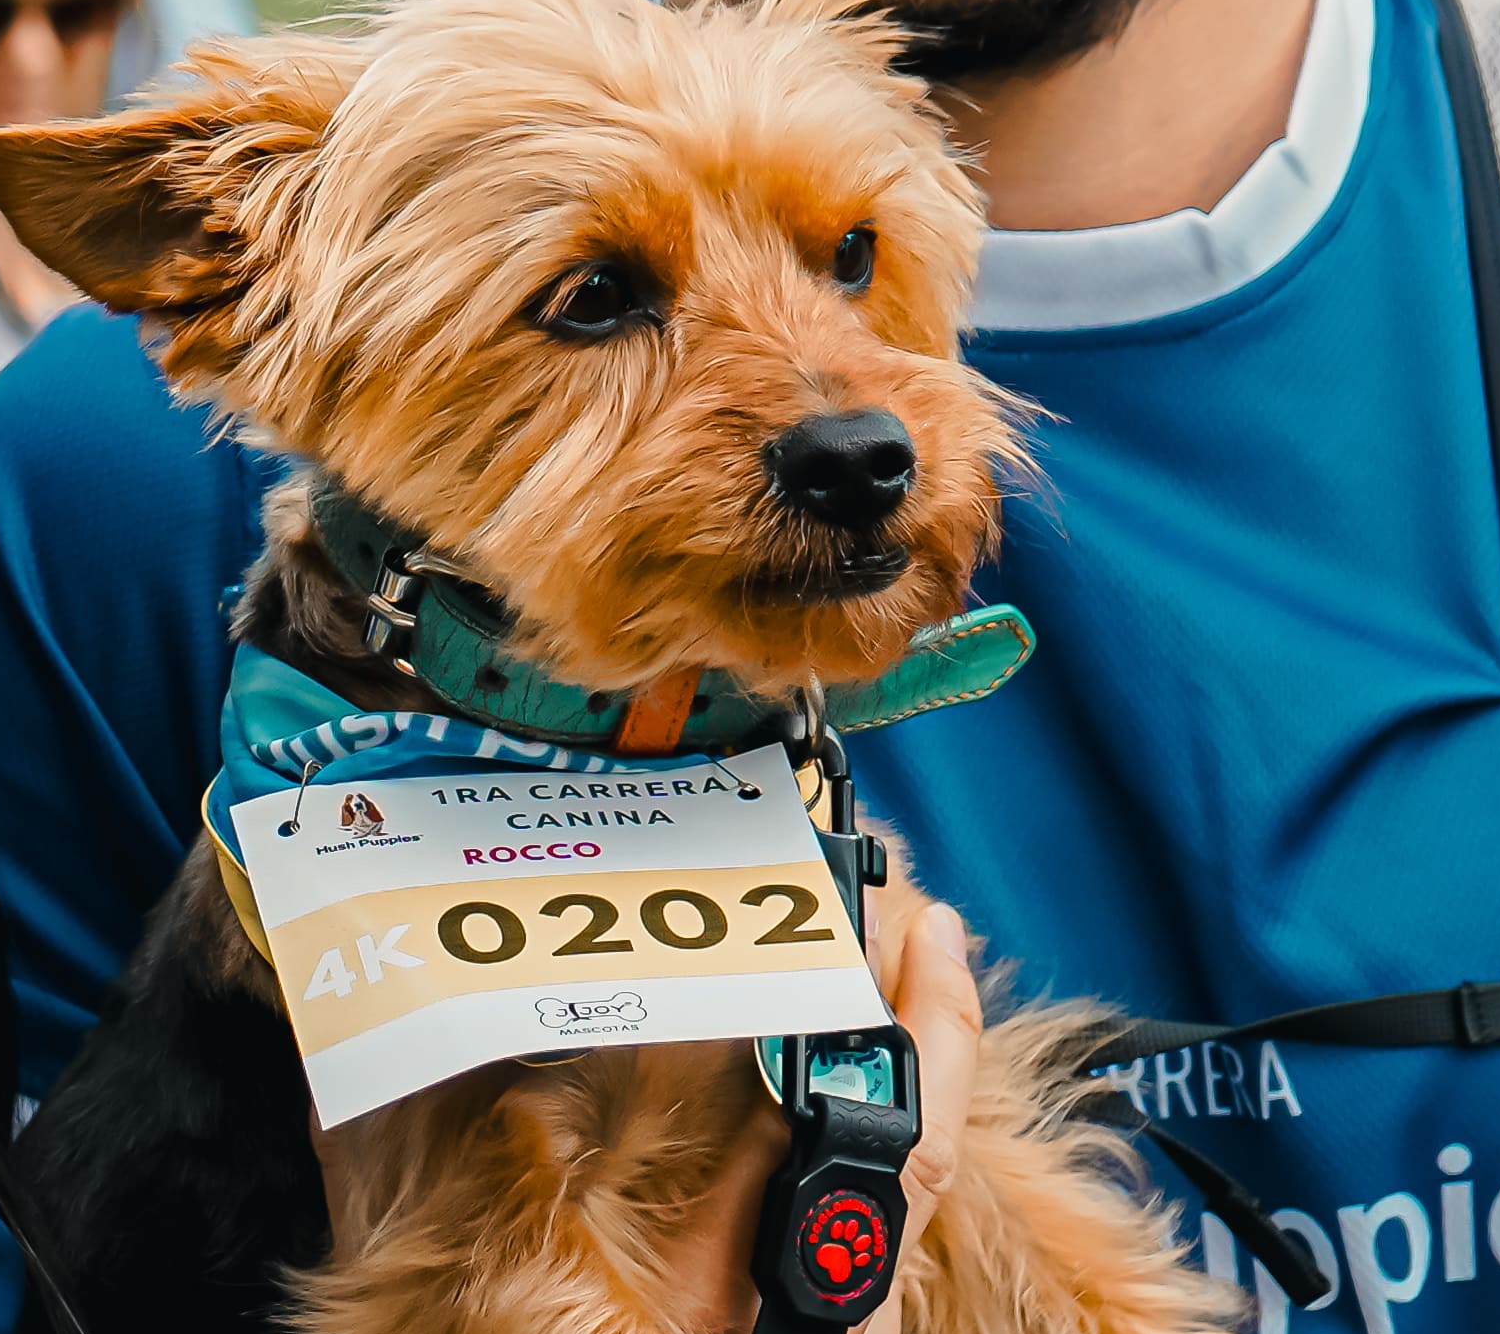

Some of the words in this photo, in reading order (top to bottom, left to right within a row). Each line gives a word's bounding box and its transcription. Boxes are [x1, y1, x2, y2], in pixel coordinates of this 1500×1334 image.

[431, 784, 511, 806] 1RA
[528, 775, 727, 802] CARRERA
[506, 808, 675, 830] CANINA
[315, 840, 355, 856] Hush
[359, 833, 420, 850] Puppies
[463, 841, 601, 865] ROCCO
[301, 923, 427, 1005] 4K
[437, 883, 836, 965] 0202
